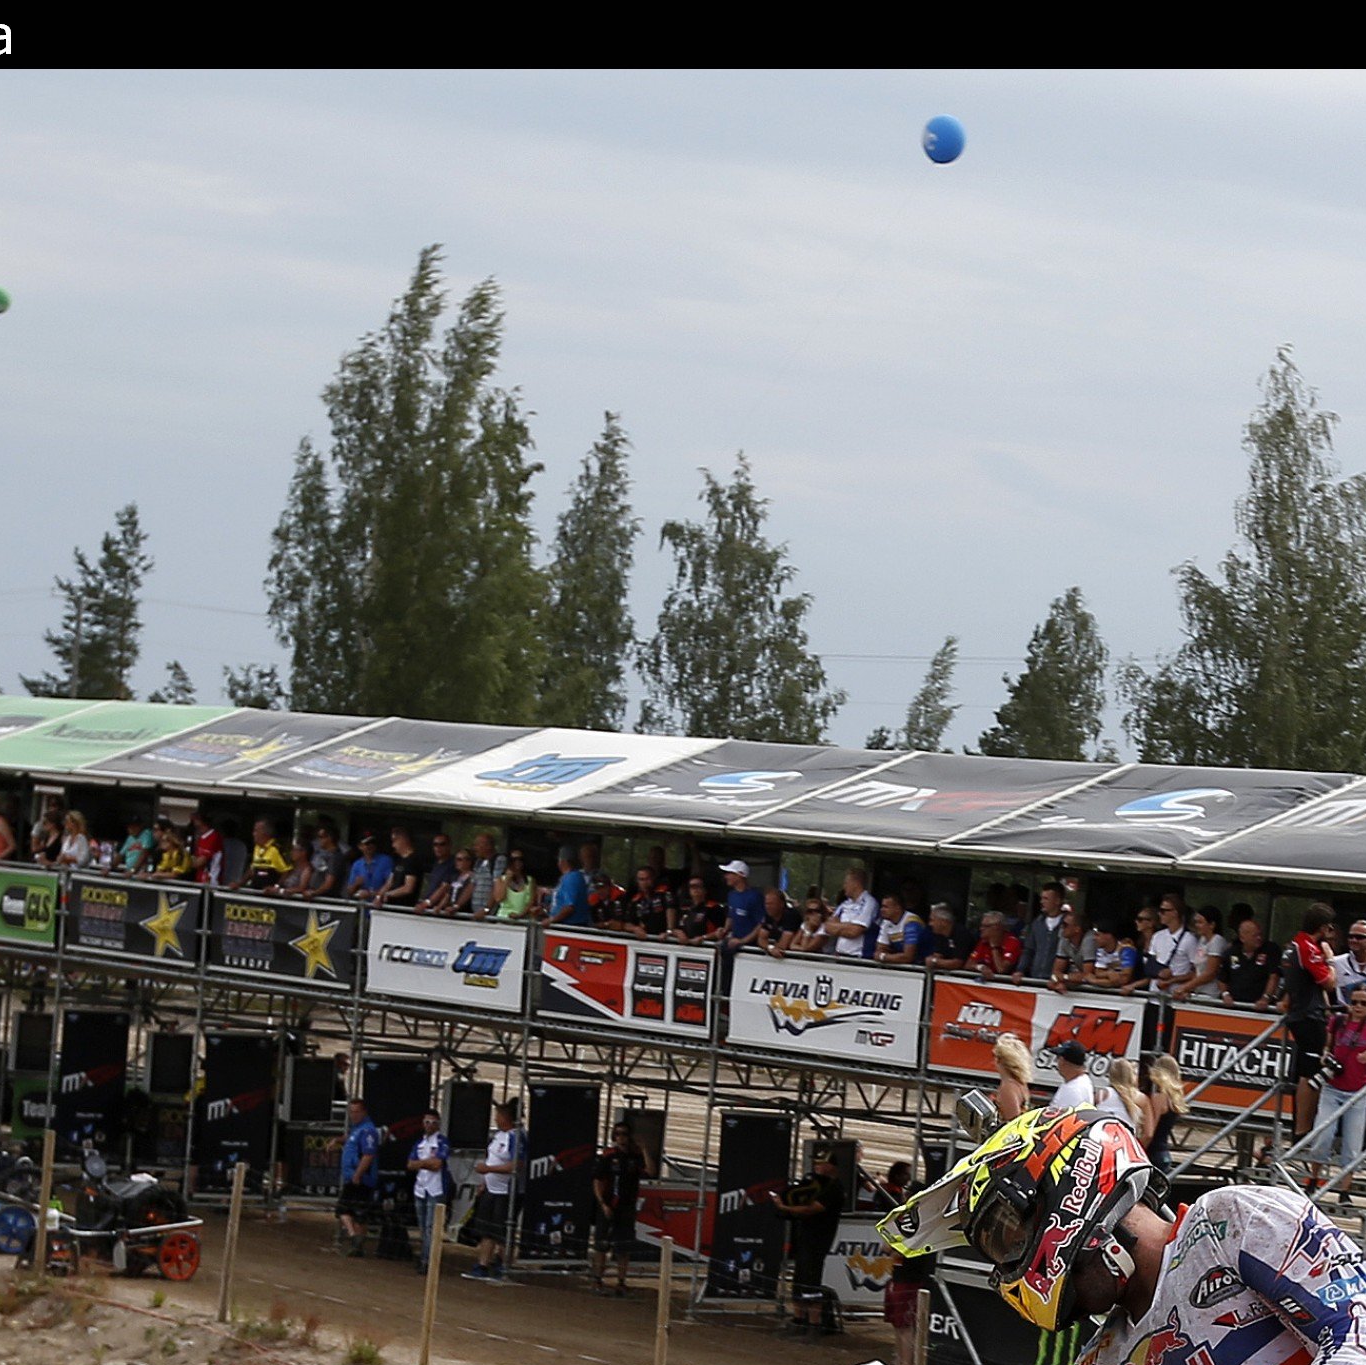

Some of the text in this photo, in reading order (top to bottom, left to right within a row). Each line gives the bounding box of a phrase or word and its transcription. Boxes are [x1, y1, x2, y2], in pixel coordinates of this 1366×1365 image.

[225, 955, 270, 970] EUROPE
[749, 977, 809, 1000] LATVIA
[837, 988, 903, 1011] RACING
[957, 1001, 1003, 1027] KTM
[1045, 1005, 1136, 1057] KTM
[1178, 1039, 1292, 1078] HITACHI
